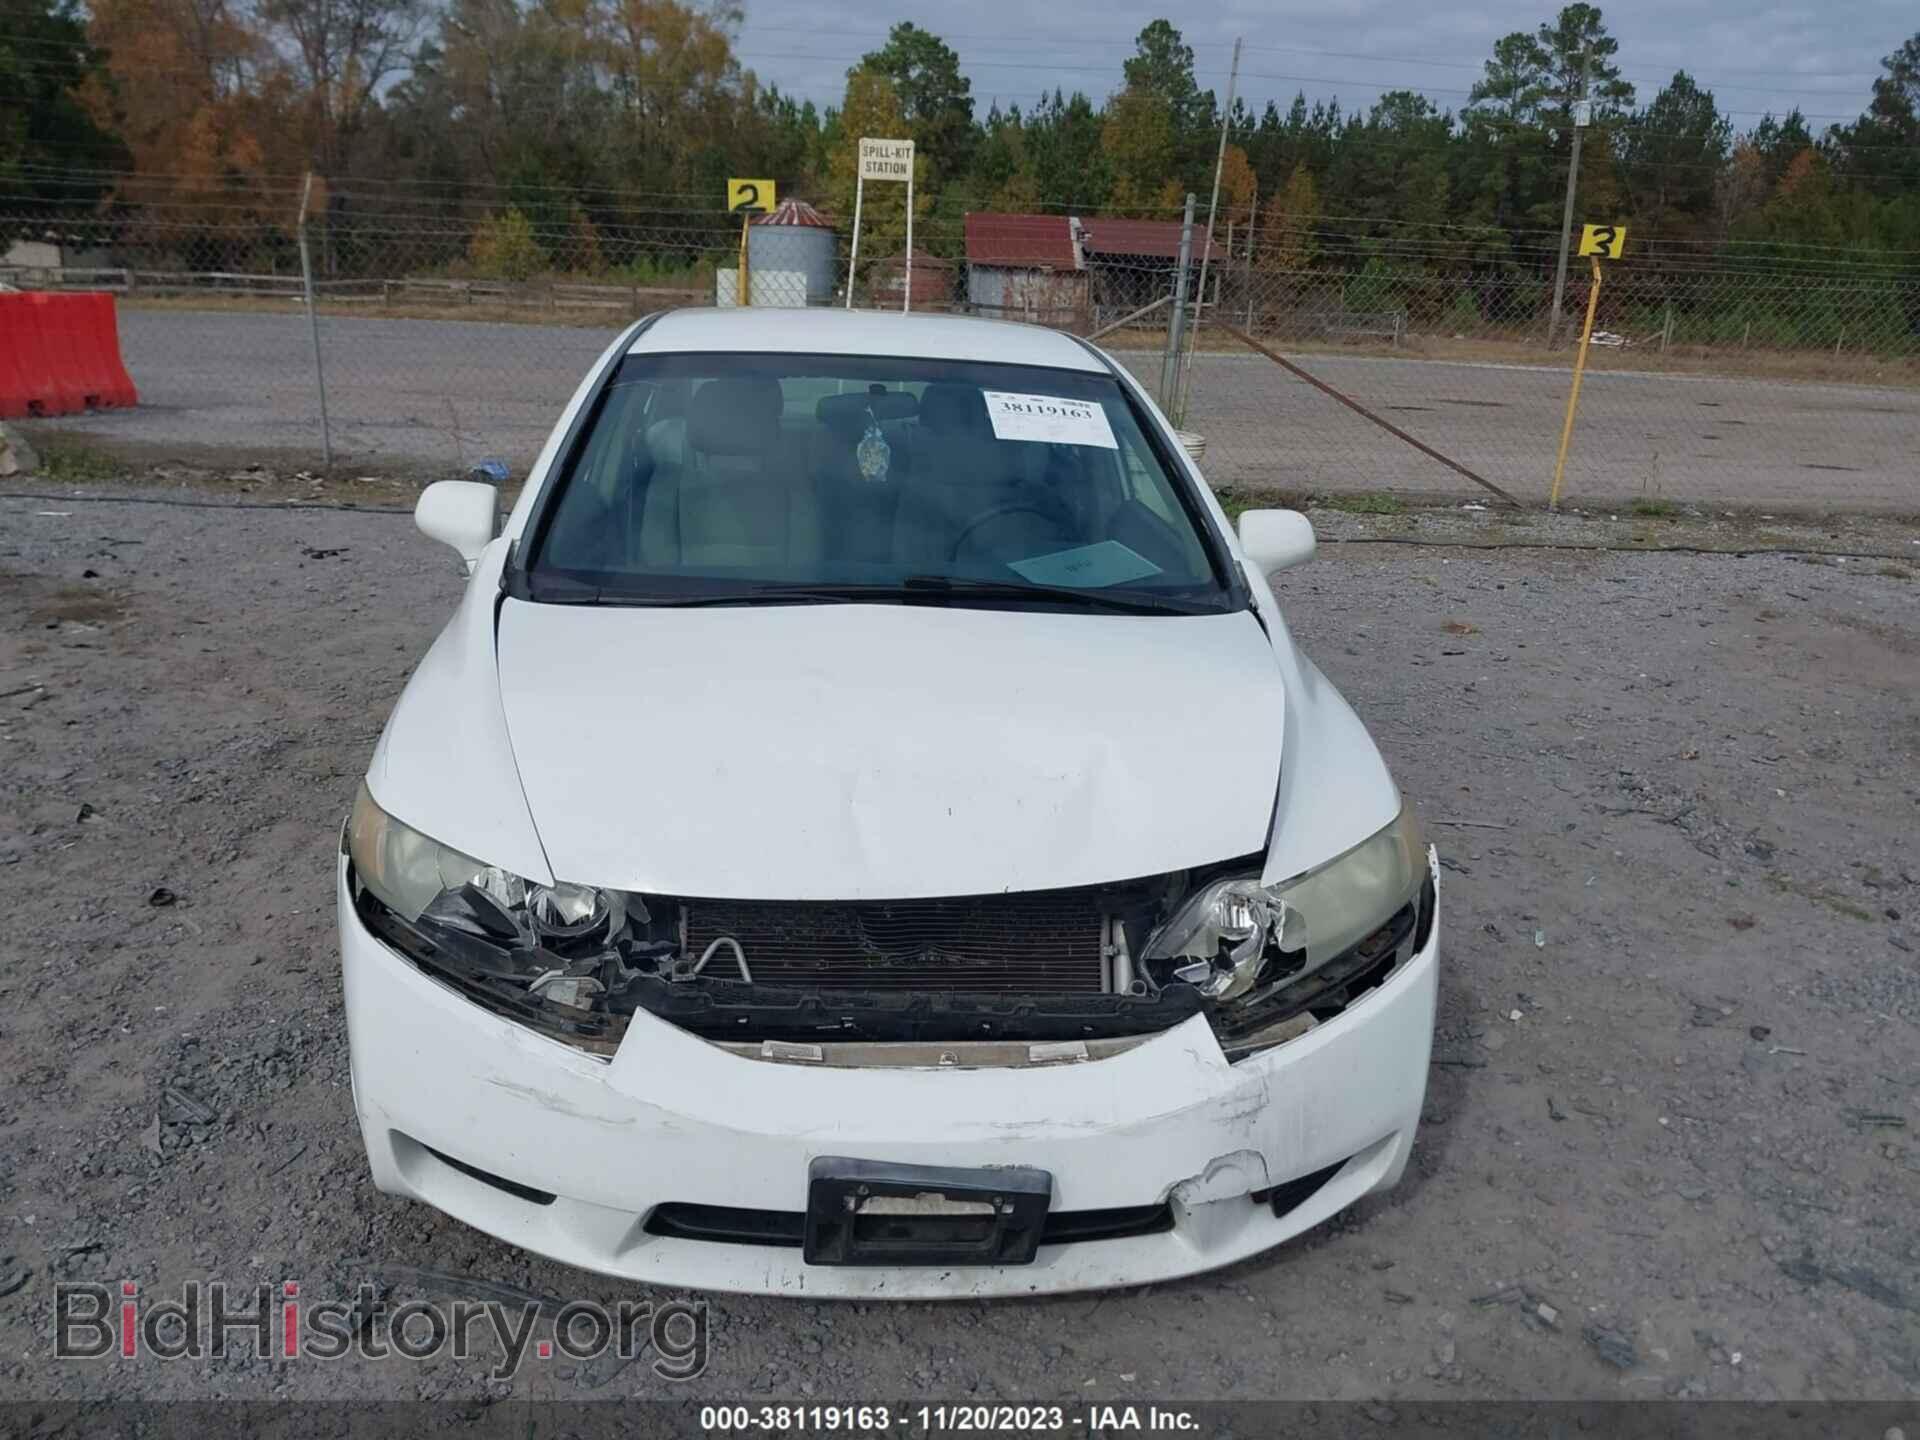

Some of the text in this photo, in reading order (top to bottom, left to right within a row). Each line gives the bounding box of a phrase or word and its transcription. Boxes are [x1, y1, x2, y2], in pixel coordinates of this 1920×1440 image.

[862, 146, 911, 159] SPILL-KIT
[864, 161, 907, 174] STATION
[734, 184, 766, 212] 2
[1589, 226, 1616, 257] 3
[1001, 401, 1092, 419] 38119163
